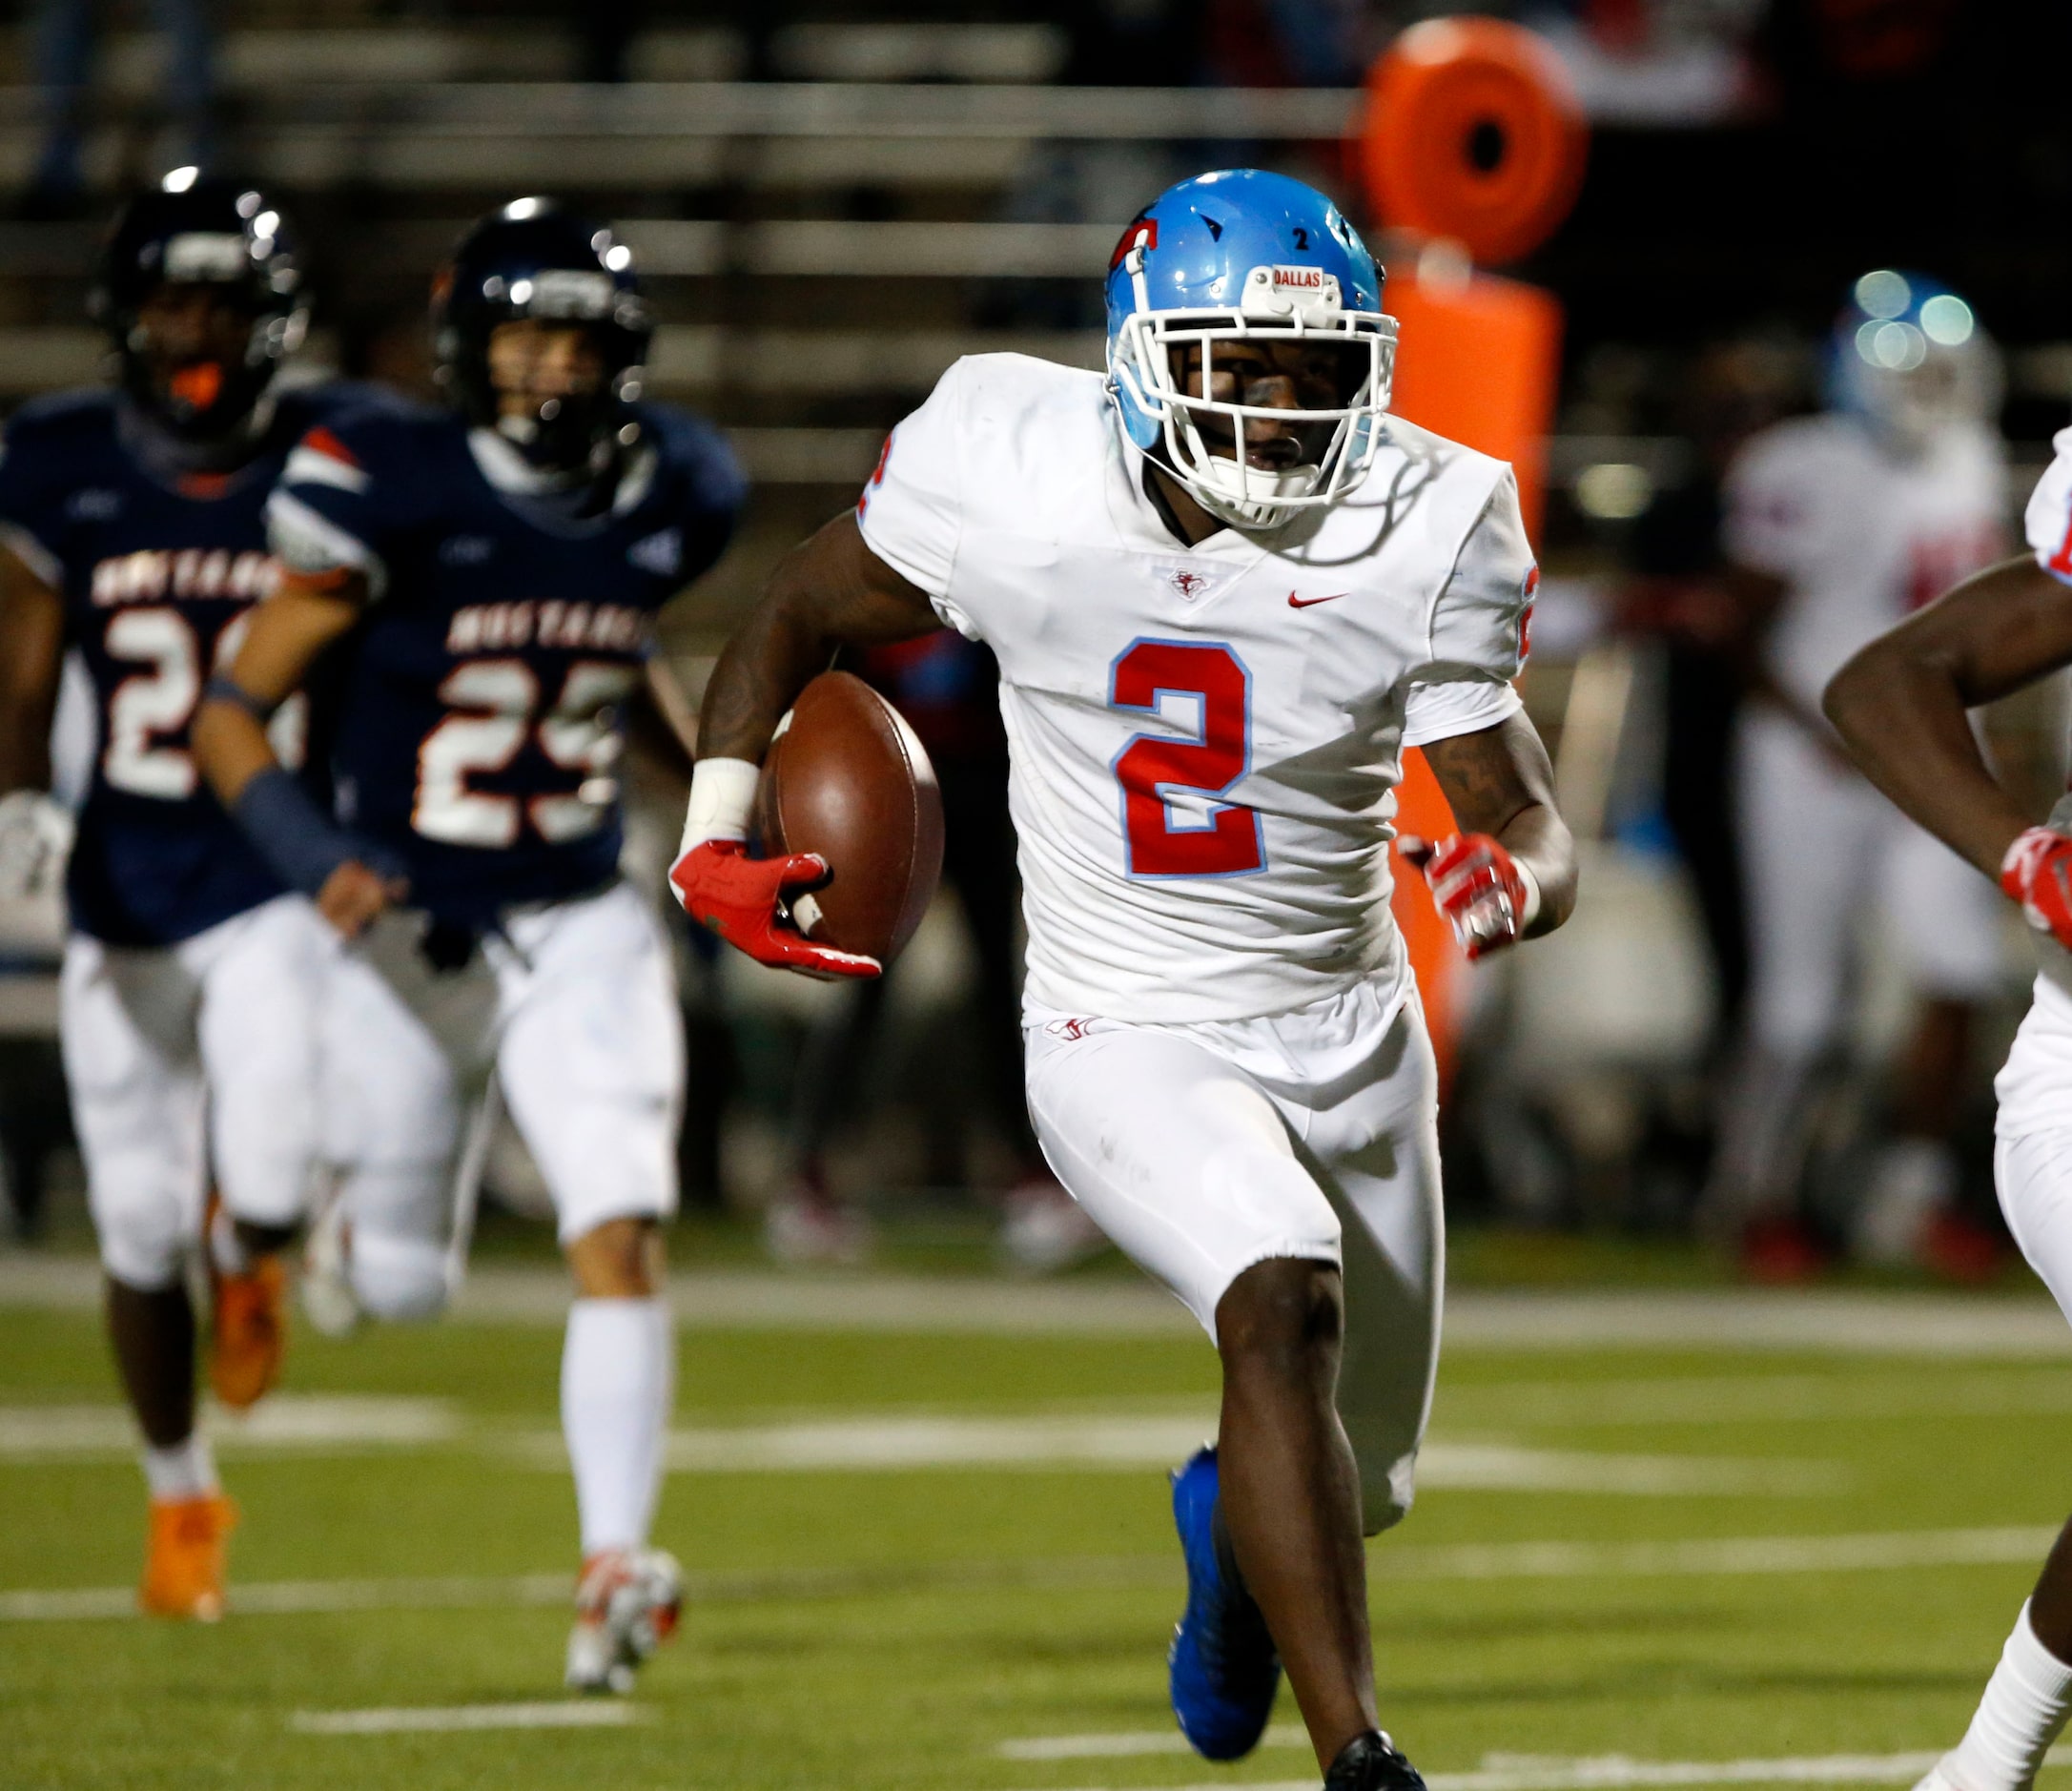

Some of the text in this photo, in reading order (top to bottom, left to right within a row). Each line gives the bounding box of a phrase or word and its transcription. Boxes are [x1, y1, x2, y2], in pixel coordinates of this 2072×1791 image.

[1274, 269, 1321, 288] DALLAS
[1292, 227, 1309, 251] 2
[103, 604, 310, 801] 2
[1107, 636, 1268, 881] 2
